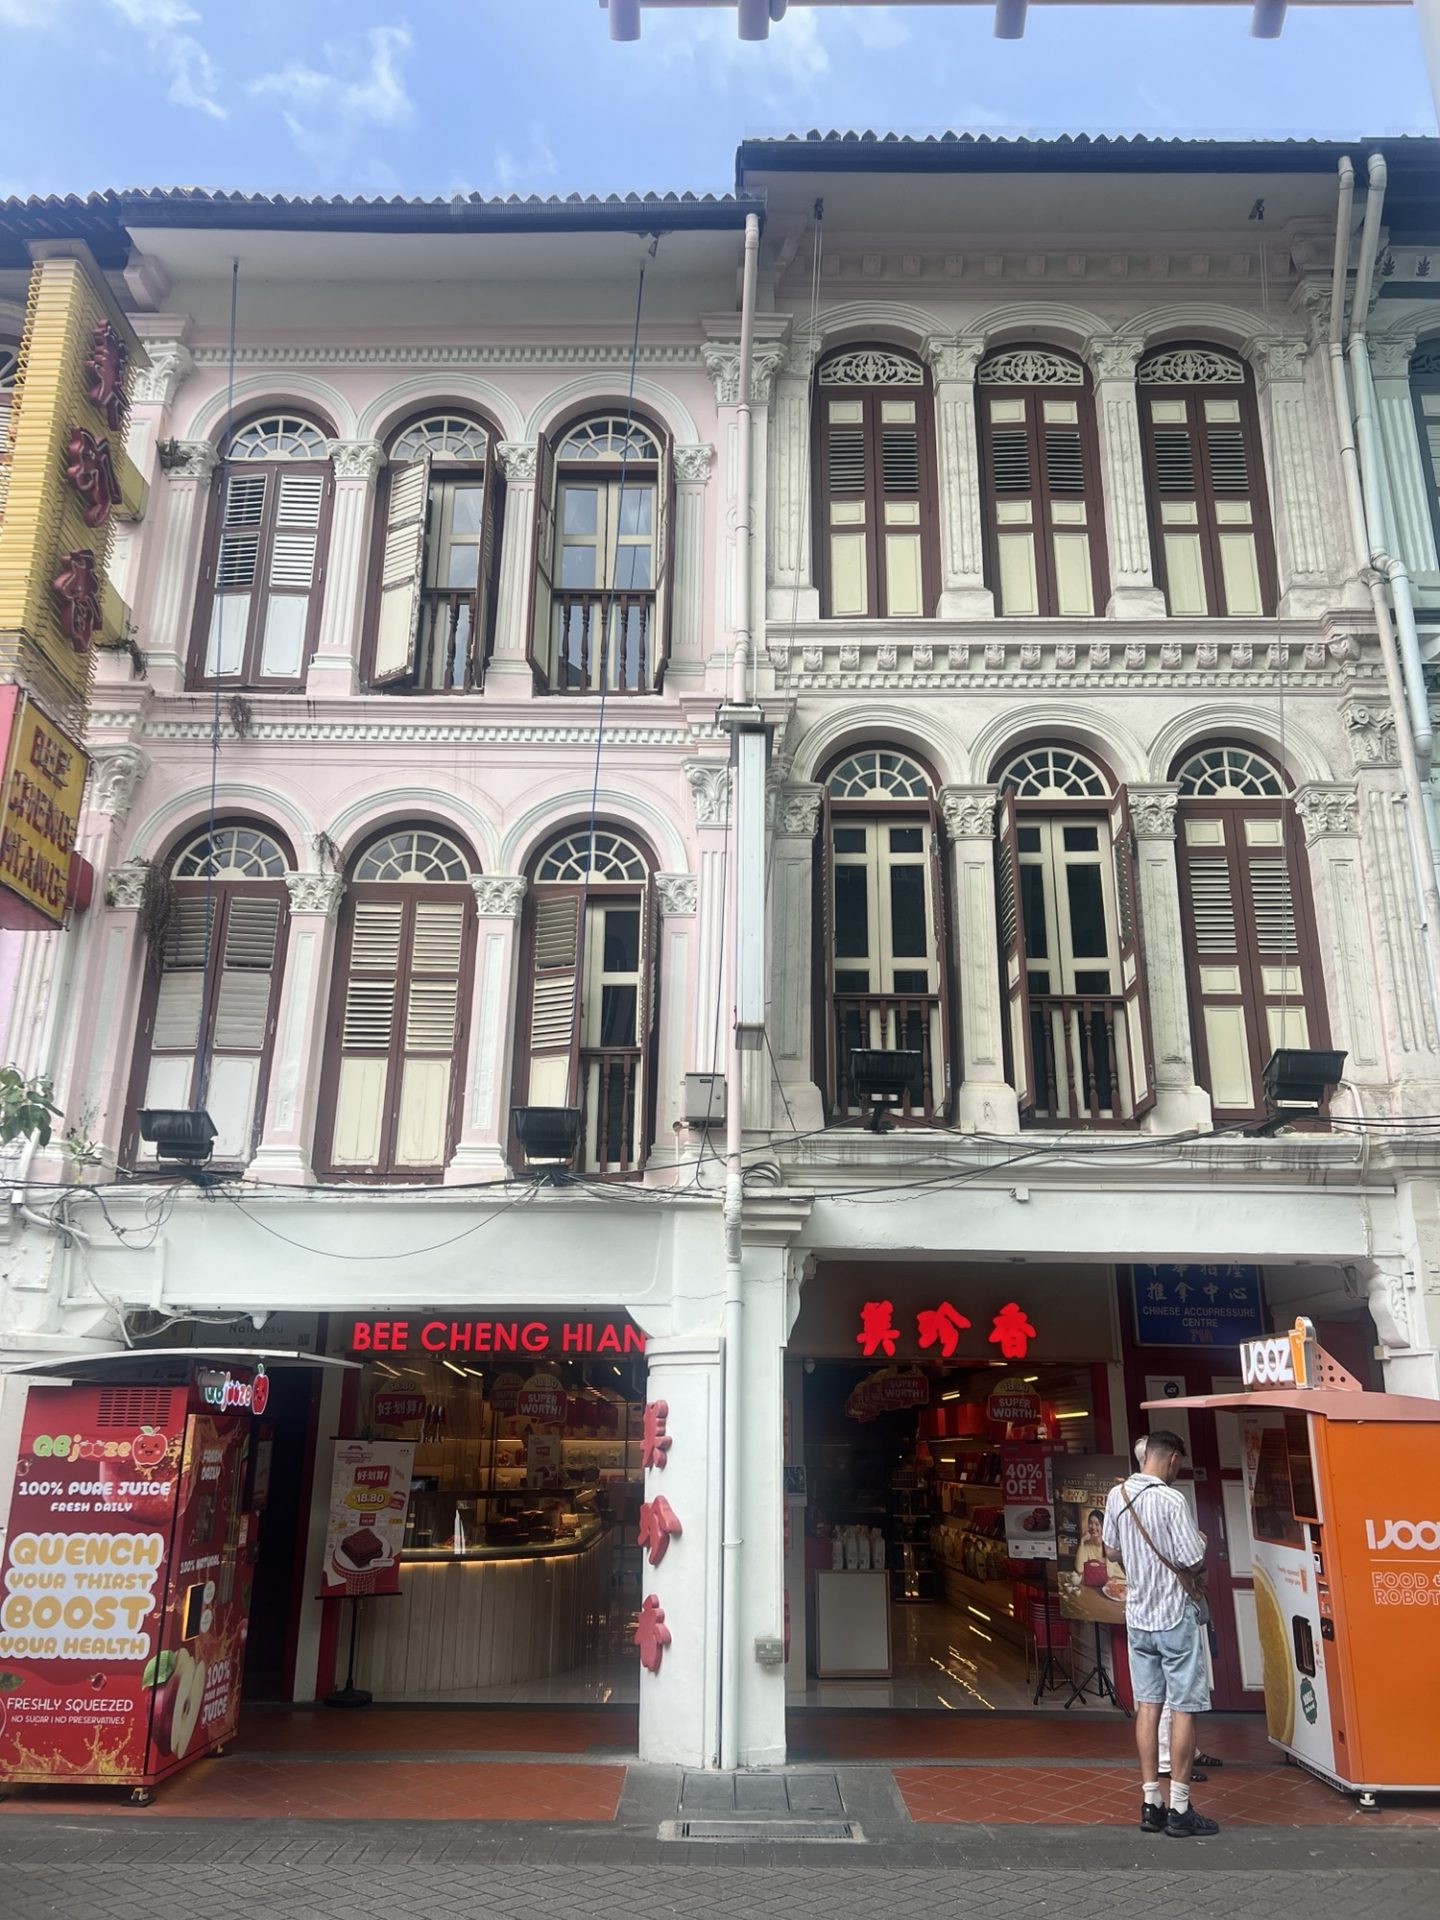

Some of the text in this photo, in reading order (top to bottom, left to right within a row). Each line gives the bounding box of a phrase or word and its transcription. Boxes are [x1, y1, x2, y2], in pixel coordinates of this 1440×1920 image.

[30, 725, 68, 776] BEE
[9, 769, 73, 855] CHENG
[1143, 1306, 1256, 1317] CHINESE ACCUPRESSURE
[856, 1300, 1036, 1358] 美珍香
[1182, 1318, 1218, 1327] CENTRE
[352, 1322, 408, 1350] BEE
[421, 1321, 549, 1351] CHENG
[890, 1380, 918, 1388] SUPER
[528, 1394, 557, 1403] SUPER
[885, 1388, 924, 1398] WORTH!
[520, 1404, 562, 1415] WORTH!
[999, 1400, 1031, 1408] SUPER
[992, 1408, 1037, 1418] WORTH!
[1006, 1464, 1042, 1478] 40%
[18, 1481, 171, 1496] 100% PURE JUICE
[1006, 1480, 1036, 1494] OFF
[50, 1502, 133, 1512] FRESH DAILY
[1365, 1519, 1440, 1550] IJOO
[14, 1537, 159, 1566] QUENCH
[9, 1572, 153, 1589] YOUR THIRST
[1371, 1571, 1429, 1588] FOOD
[5, 1595, 150, 1630] BOOST
[0, 1637, 145, 1655] YOUR HEALTH
[206, 1659, 231, 1688] 100%
[7, 1697, 133, 1713] FRESHLY SQUEEZED
[201, 1695, 228, 1725] JUICE
[11, 1715, 24, 1723] NO
[25, 1715, 49, 1723] SUGAR
[55, 1716, 66, 1724] NO
[68, 1716, 125, 1725] PRESERVATIVES
